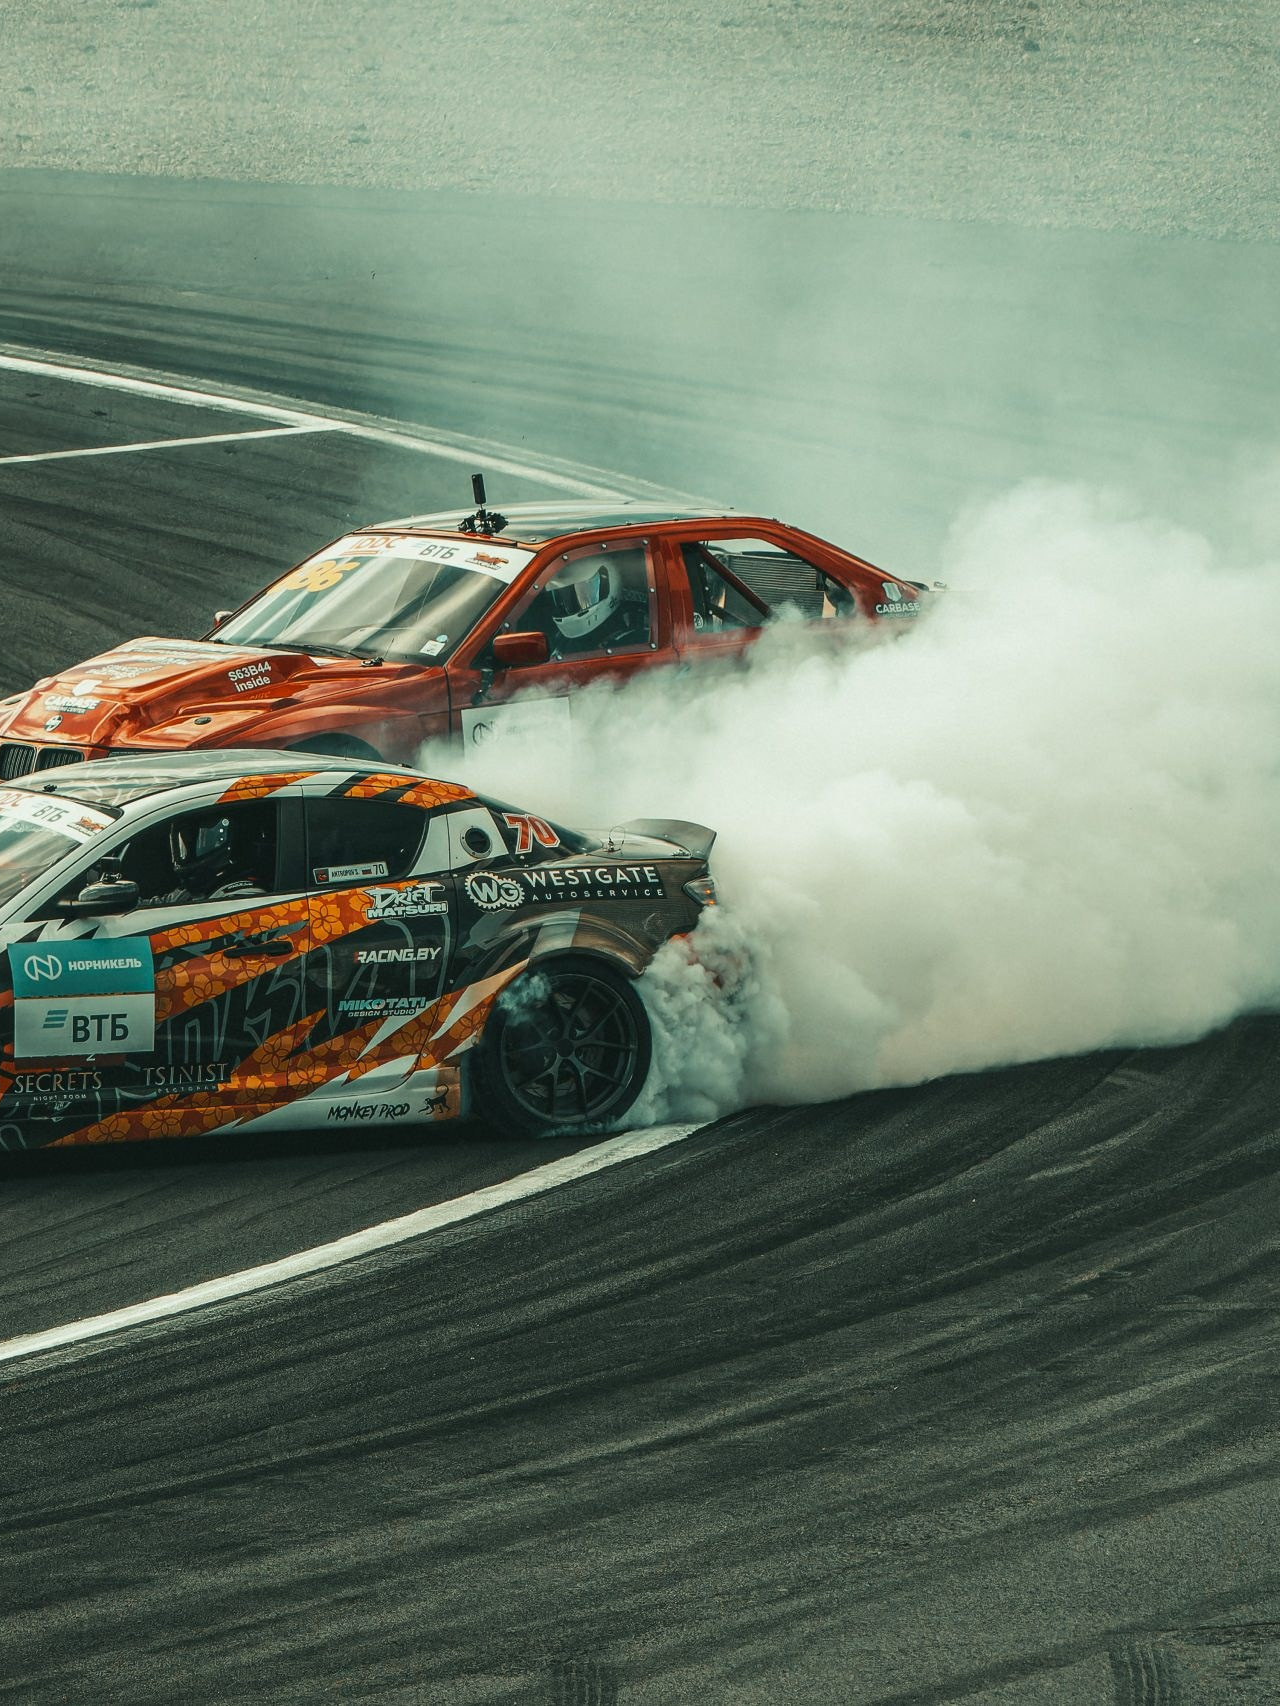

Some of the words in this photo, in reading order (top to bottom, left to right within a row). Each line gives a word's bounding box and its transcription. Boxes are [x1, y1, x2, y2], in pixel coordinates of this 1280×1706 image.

[419, 544, 460, 559] ВТБ
[875, 602, 921, 614] CARBASE
[228, 661, 272, 682] S63B44
[234, 676, 271, 692] inside
[32, 805, 70, 823] ВТБ
[502, 812, 560, 855] 70
[372, 863, 385, 876] 70
[523, 866, 660, 888] WESTGATE
[532, 888, 664, 902] AUTOSERVICE
[366, 902, 448, 919] MATSURI
[353, 946, 442, 964] RACING.BY
[68, 958, 142, 971] НОРНИКЕЛЬ
[382, 1008, 415, 1016] STUDIO
[72, 1013, 129, 1043] ВТБ
[14, 1071, 103, 1094] SECRETS
[142, 1062, 228, 1087] TSINIST
[327, 1100, 378, 1121] MONKEY
[379, 1102, 411, 1120] PROD
